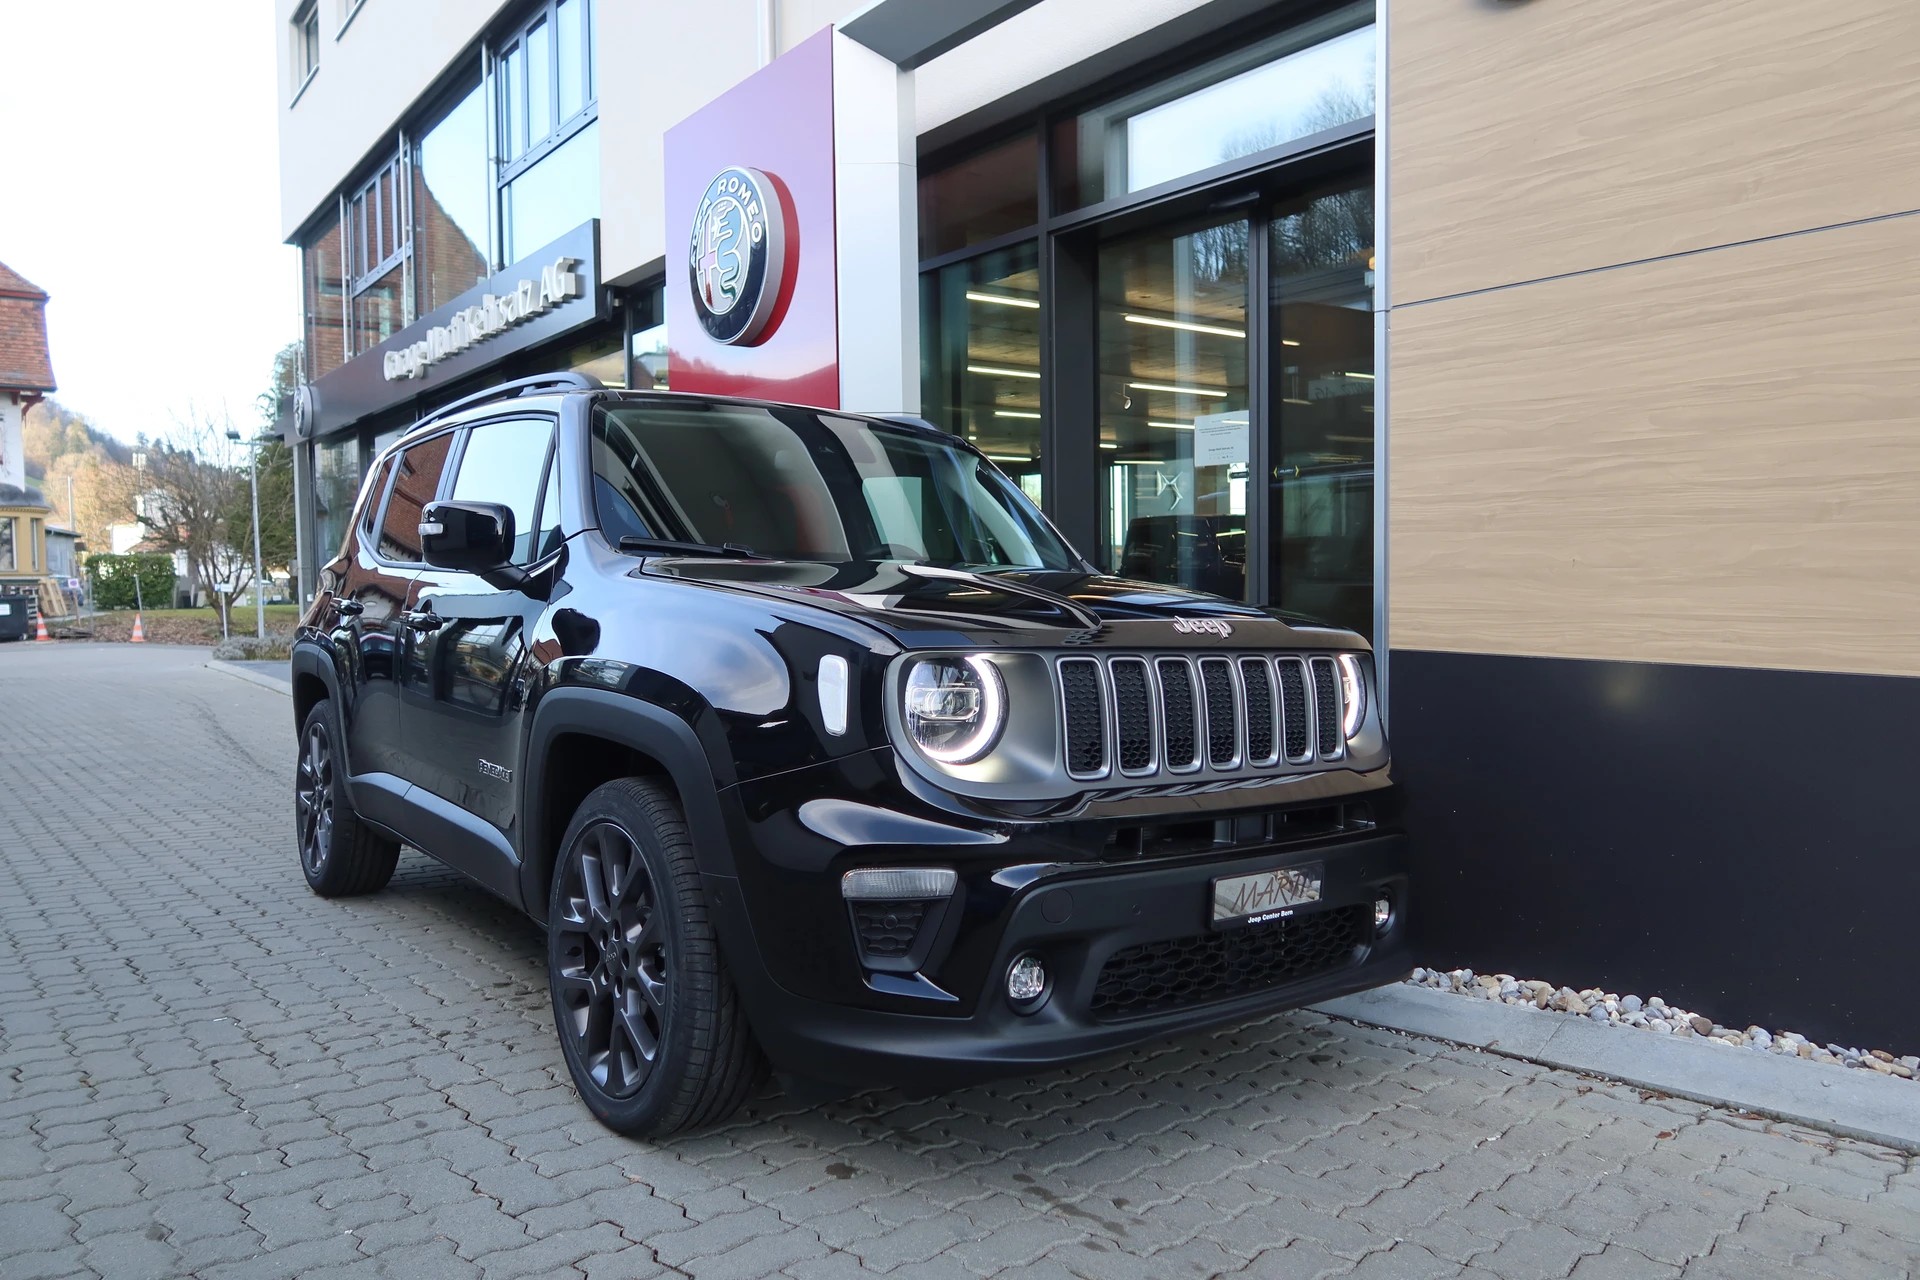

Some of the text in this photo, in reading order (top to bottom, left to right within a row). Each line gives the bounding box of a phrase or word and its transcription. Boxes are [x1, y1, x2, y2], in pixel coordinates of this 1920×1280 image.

[717, 177, 763, 243] ROMEO
[540, 256, 576, 307] AG
[1173, 615, 1232, 639] Jeep
[1262, 913, 1281, 921] Center
[1281, 909, 1294, 917] Bern
